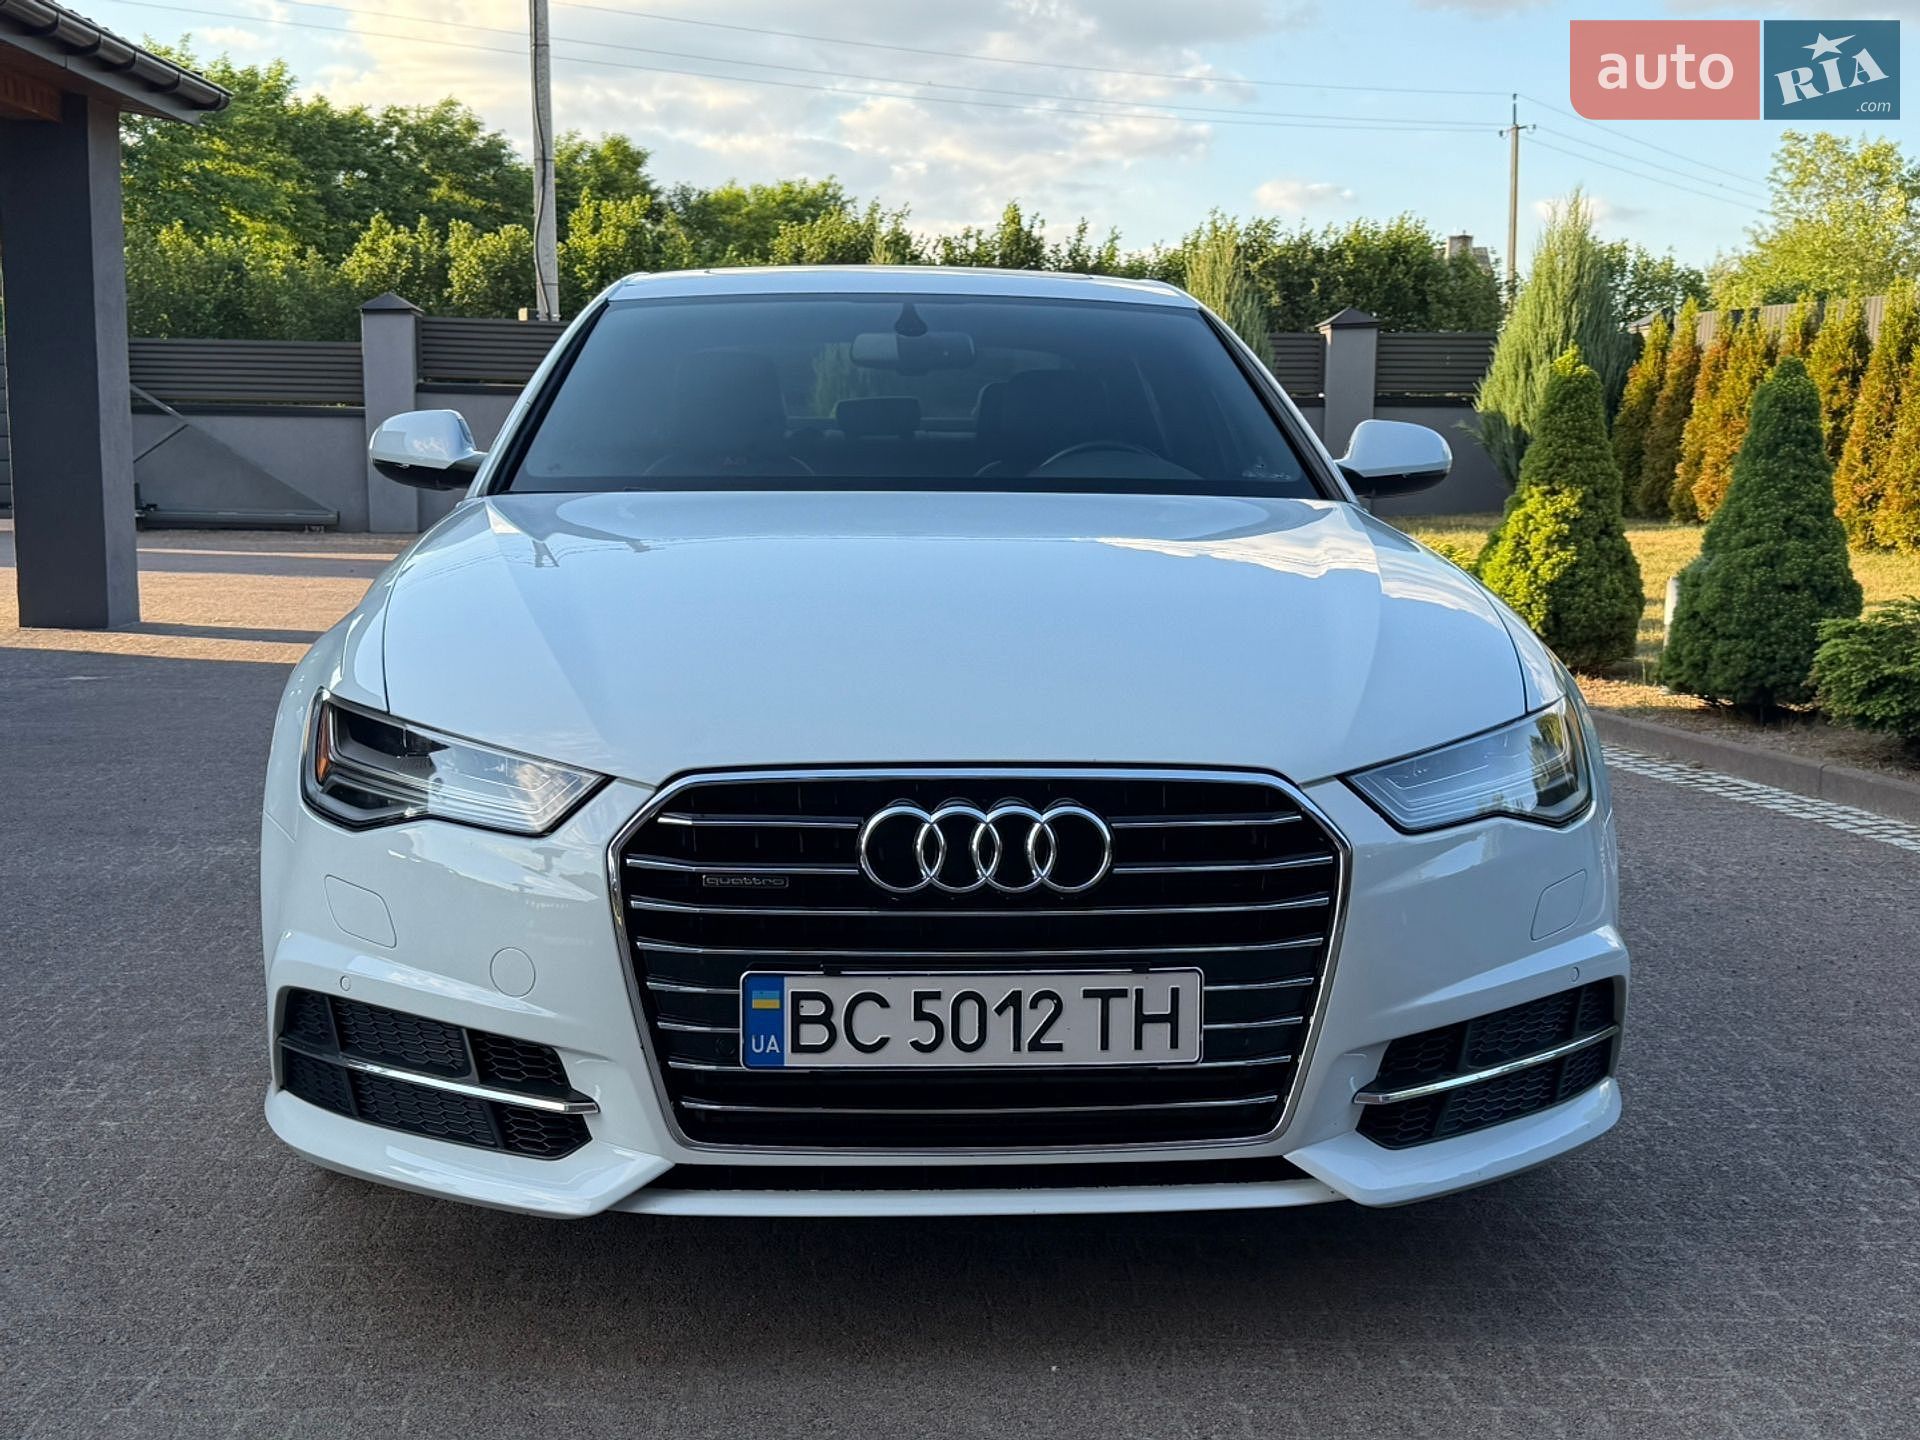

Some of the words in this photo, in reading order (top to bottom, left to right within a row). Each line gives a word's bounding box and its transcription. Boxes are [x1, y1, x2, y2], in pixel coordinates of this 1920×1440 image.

[706, 877, 785, 886] quattro
[790, 990, 891, 1053] BC
[909, 989, 1064, 1053] 5012
[1082, 986, 1180, 1051] TH
[751, 1035, 780, 1053] UA
